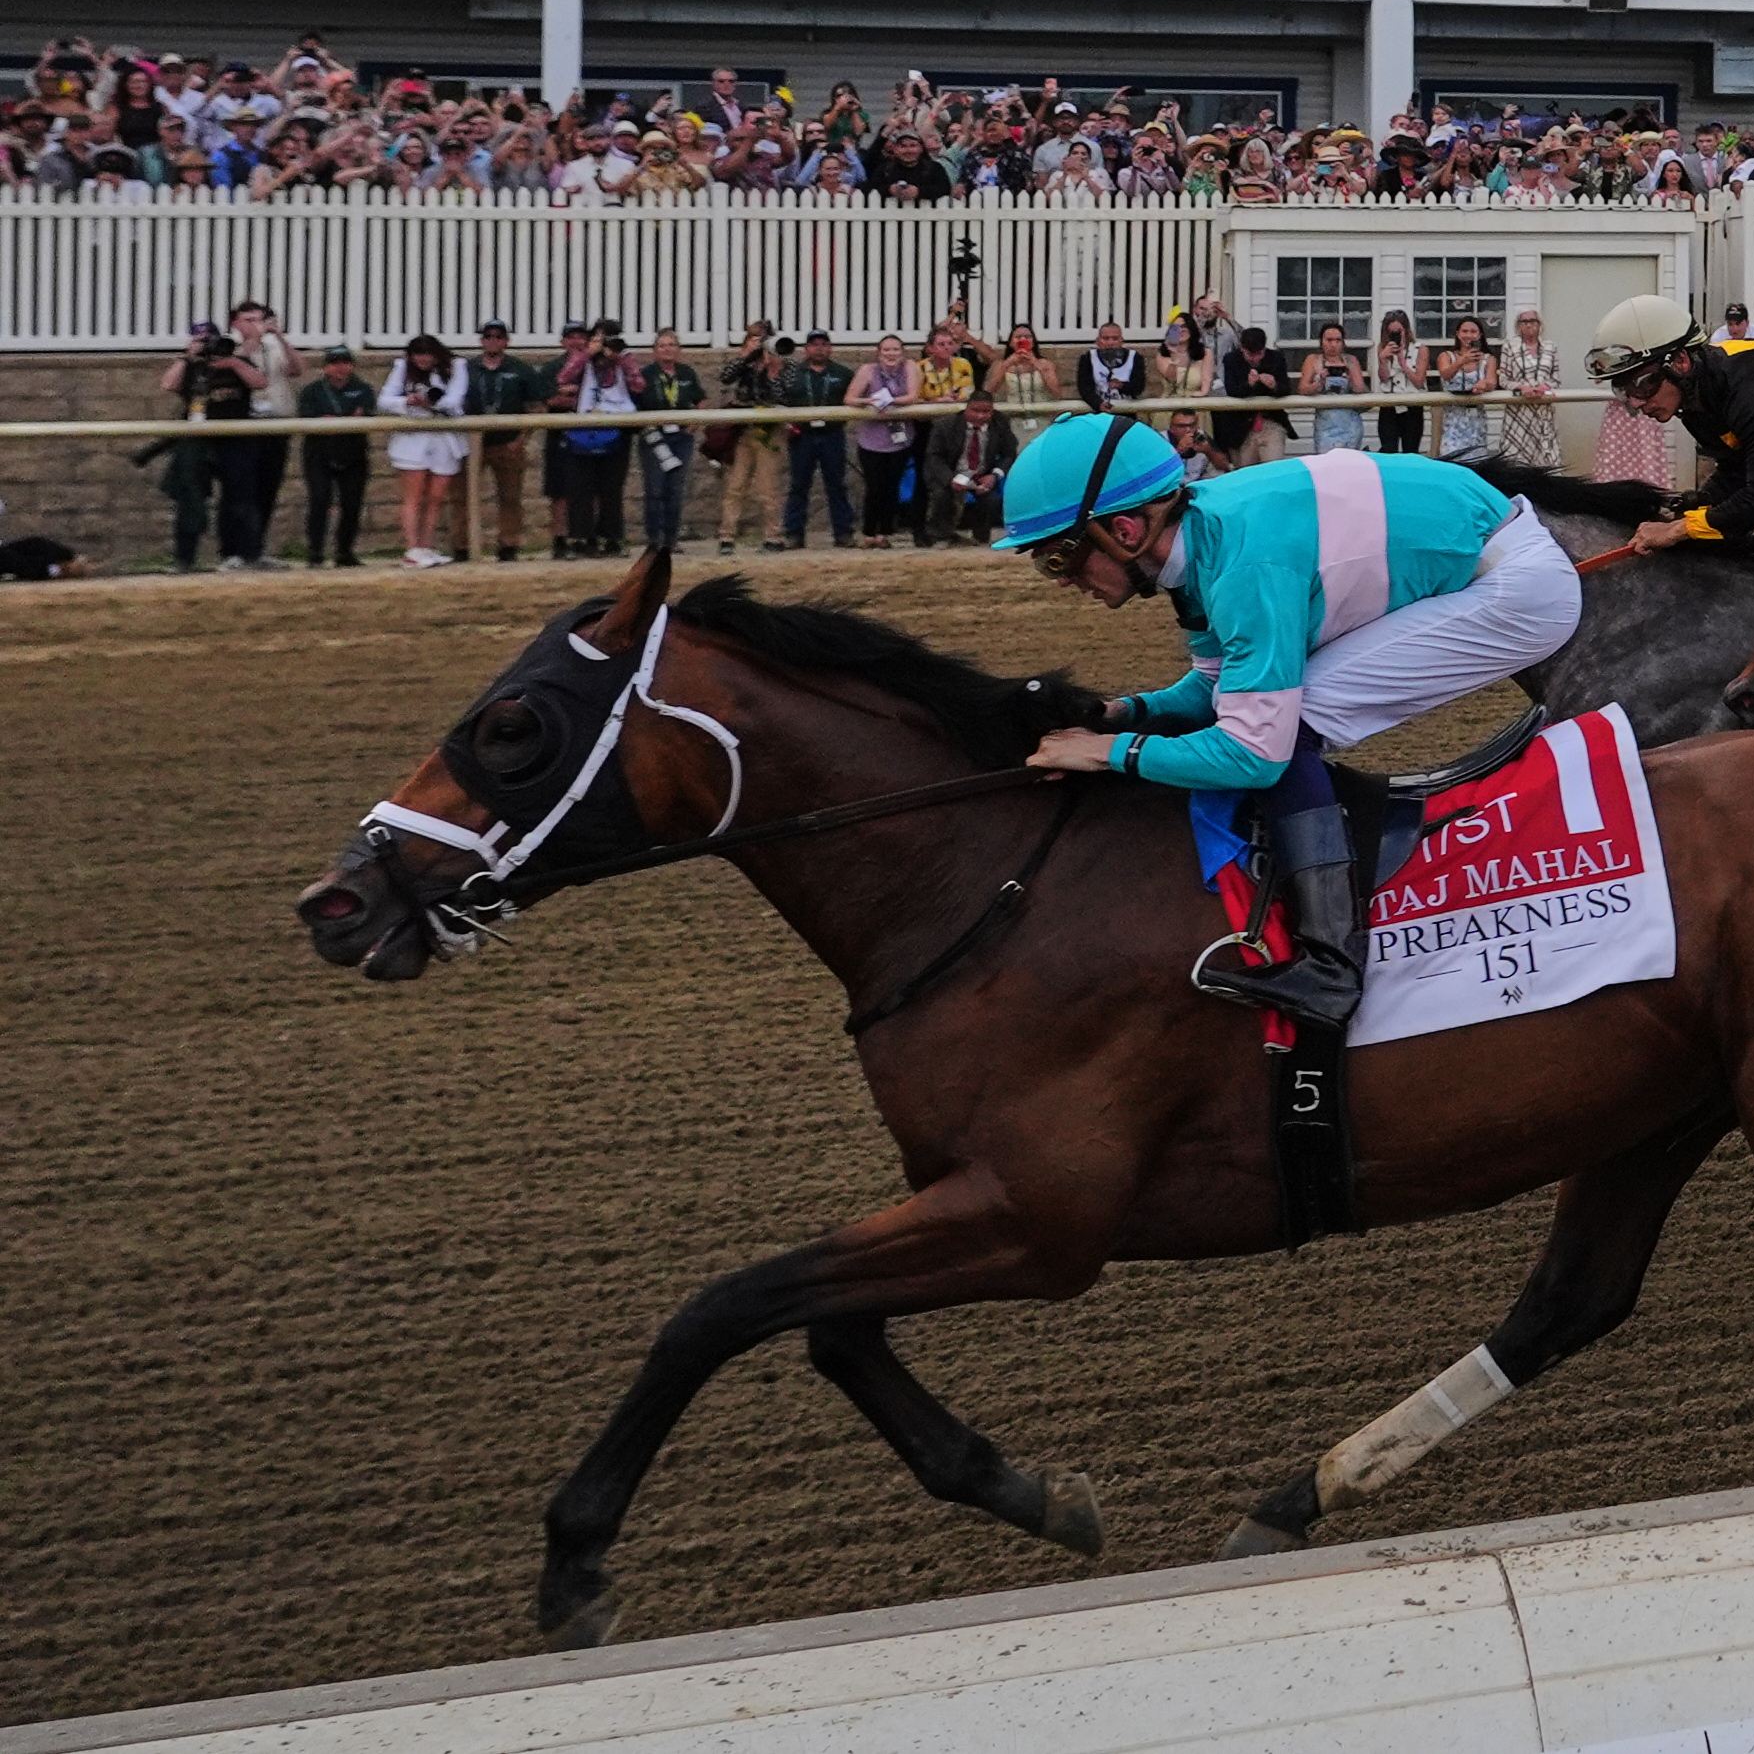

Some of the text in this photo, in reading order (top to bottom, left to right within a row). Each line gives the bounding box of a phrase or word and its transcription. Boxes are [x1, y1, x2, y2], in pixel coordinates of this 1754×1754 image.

[1535, 718, 1605, 834] 1
[1369, 839, 1631, 922] TAJ MAHAL
[1374, 883, 1631, 963] PREAKNESS
[1476, 939, 1540, 983] 151
[1293, 1070, 1323, 1112] 5
